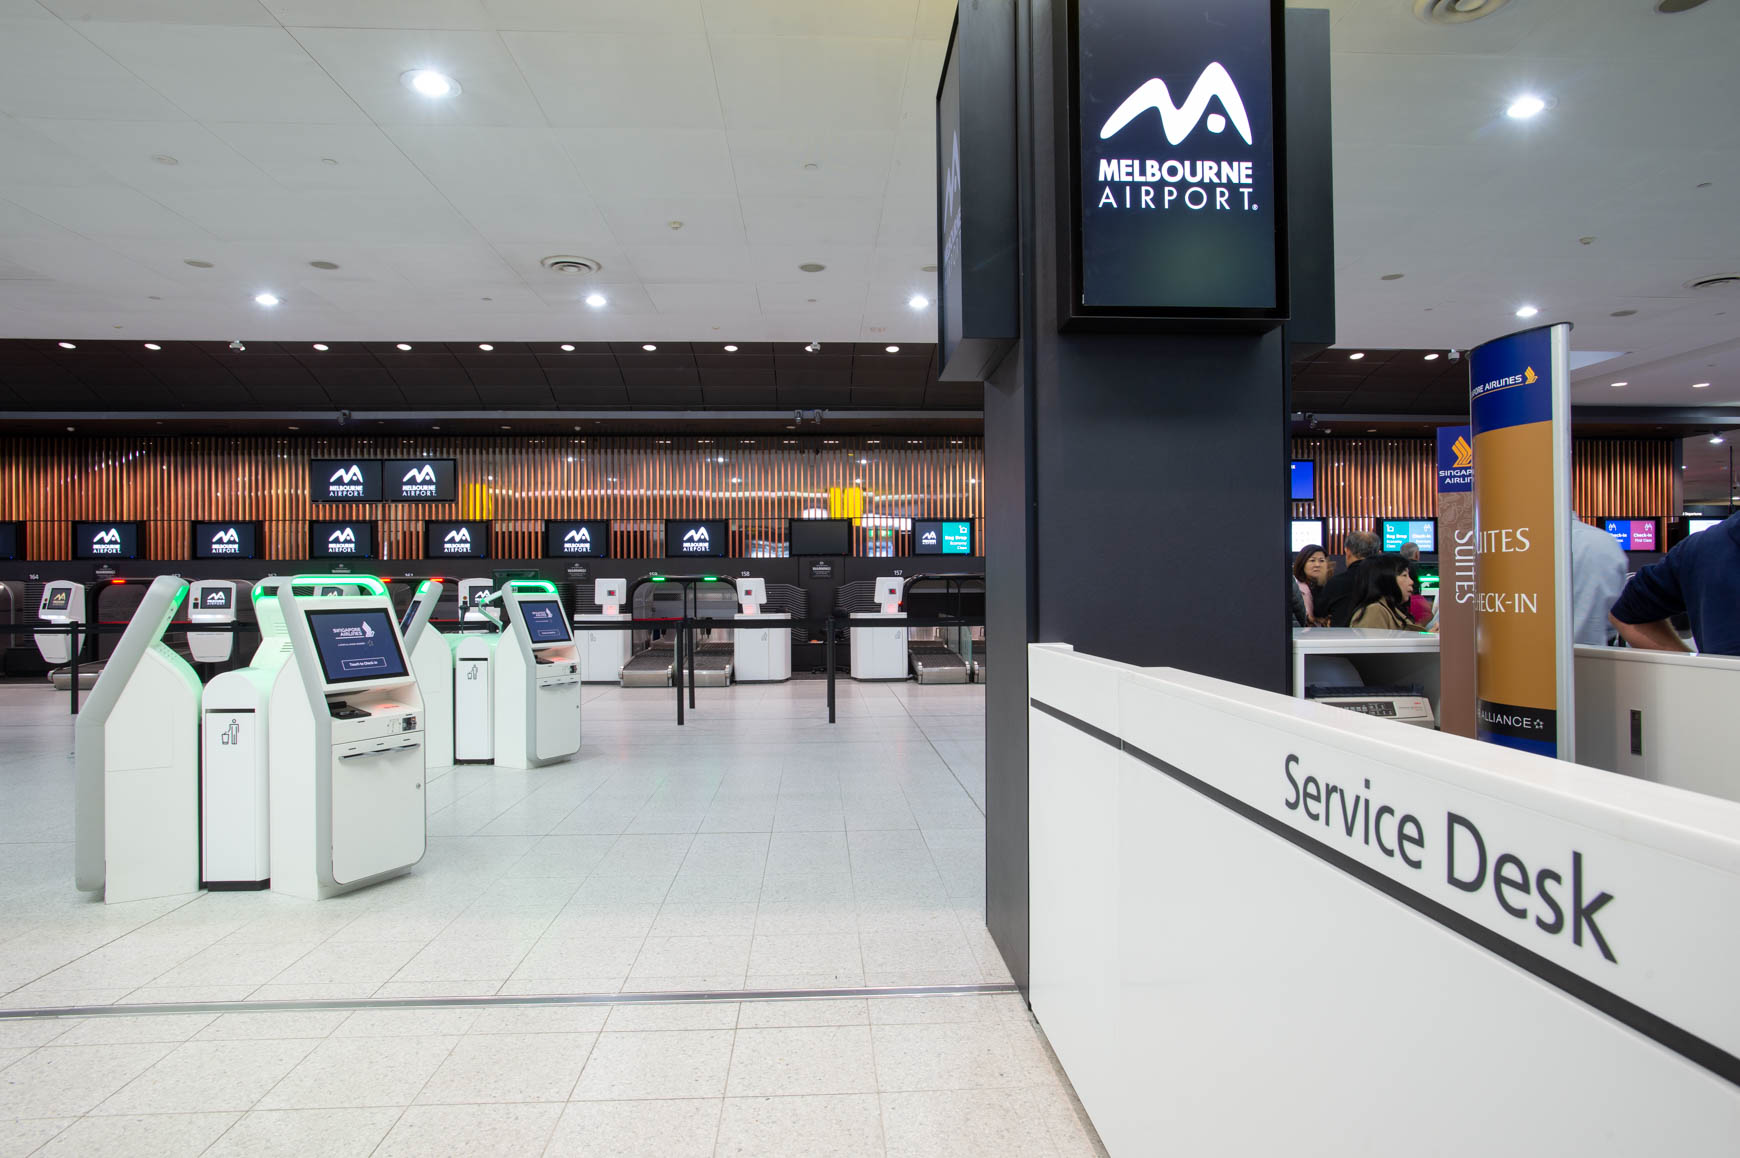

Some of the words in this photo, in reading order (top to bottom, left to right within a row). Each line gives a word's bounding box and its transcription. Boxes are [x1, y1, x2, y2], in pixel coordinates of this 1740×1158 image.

[1098, 159, 1253, 184] MELBOURNE
[1484, 374, 1522, 392] AIRLINES
[1476, 528, 1530, 554] UITES
[1454, 530, 1475, 604] SUITES
[1473, 592, 1537, 614] HECK-IN
[1284, 754, 1425, 870] Service
[1447, 812, 1618, 964] Desk
